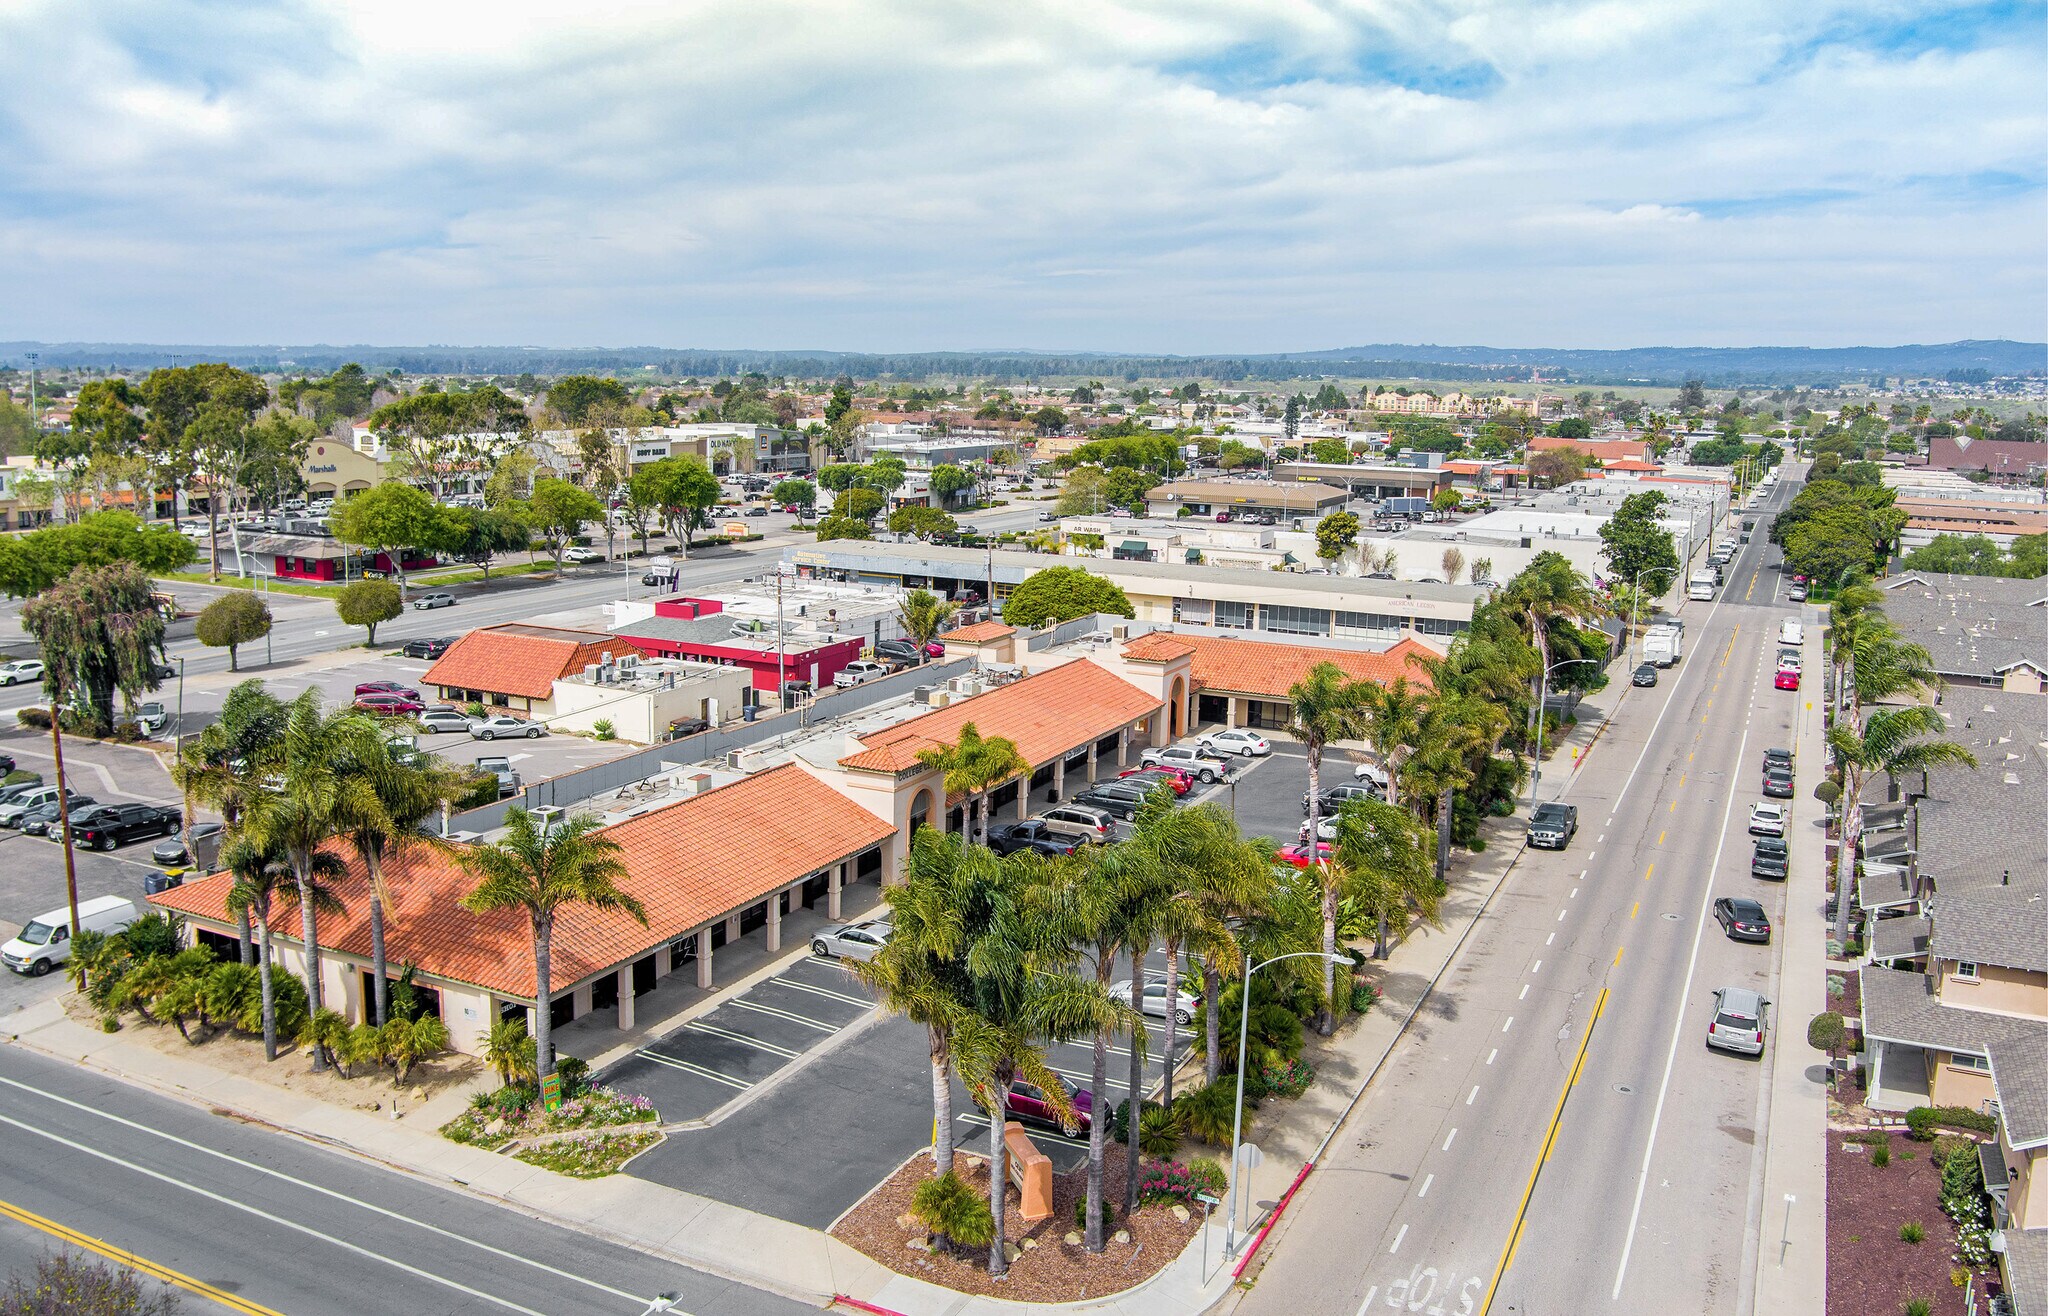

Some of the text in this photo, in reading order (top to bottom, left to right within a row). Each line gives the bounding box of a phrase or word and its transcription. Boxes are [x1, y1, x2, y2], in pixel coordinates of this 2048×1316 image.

[308, 464, 337, 474] Marshalls
[898, 765, 922, 781] COLLEGE
[544, 1083, 560, 1095] BIKE
[1385, 1263, 1483, 1316] STOP
